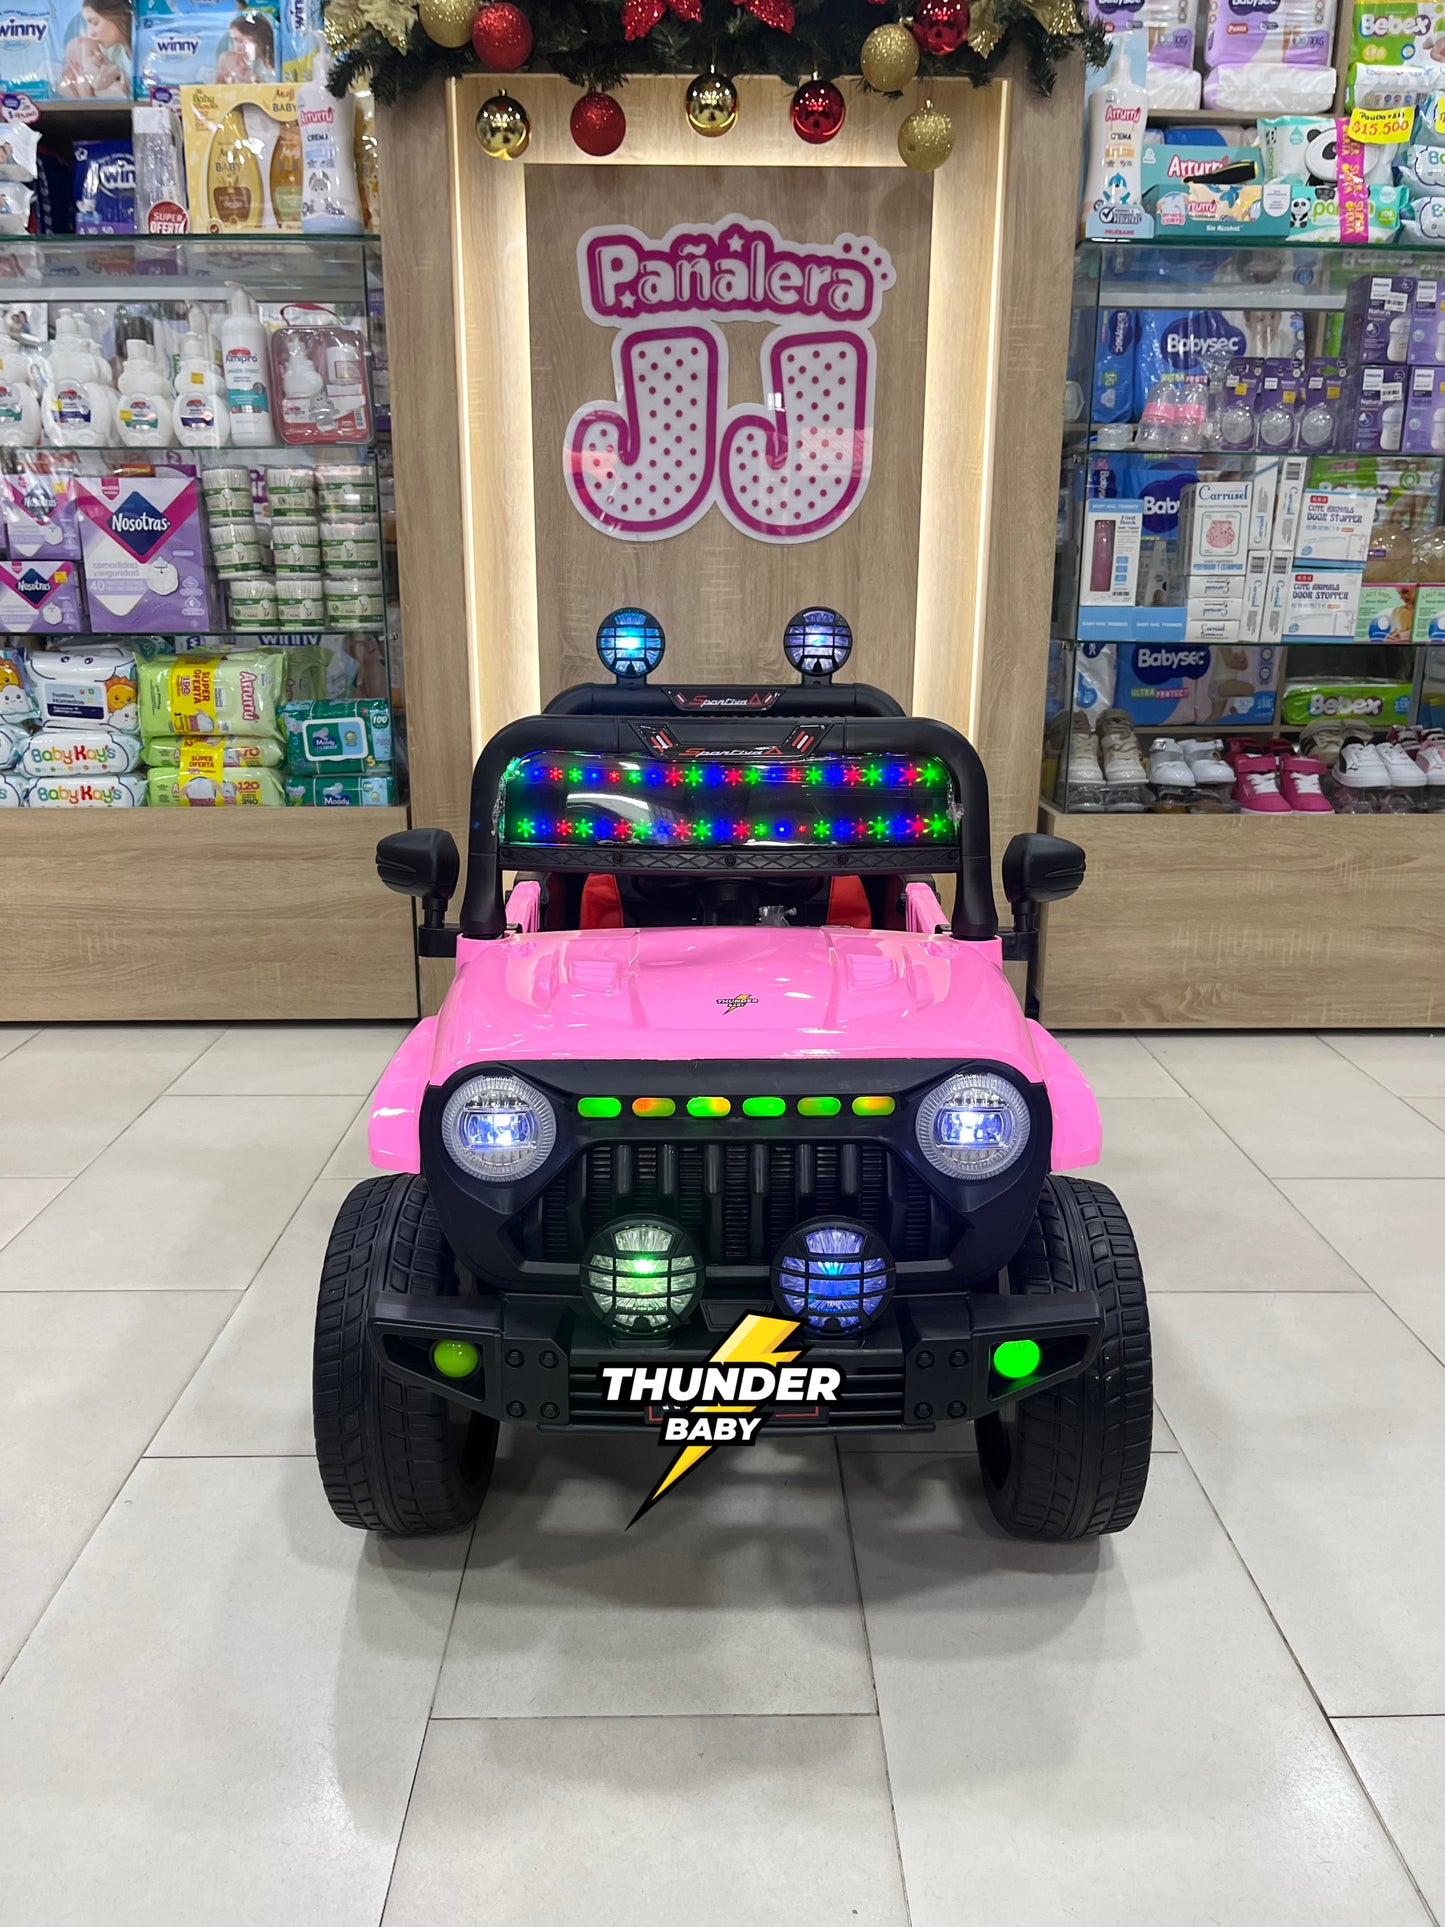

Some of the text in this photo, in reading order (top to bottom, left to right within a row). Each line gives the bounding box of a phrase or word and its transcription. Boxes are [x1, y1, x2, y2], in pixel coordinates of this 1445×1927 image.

[294, 0, 305, 29] win
[1361, 13, 1431, 37] Bebex
[0, 19, 46, 40] winny
[157, 36, 199, 54] winny
[1105, 105, 1142, 122] Arrurrú
[105, 161, 136, 184] win
[592, 238, 868, 314] Pañalera
[1166, 333, 1241, 355] Babysec
[571, 326, 868, 536] JJ
[1199, 484, 1249, 501] Carrusel
[112, 512, 169, 532] Nosotras
[1307, 513, 1363, 523] DOOR STOPPER
[17, 578, 51, 591] Nosotras
[1293, 583, 1311, 591] CUTE
[1292, 591, 1349, 600] DOOR STOPPER
[1137, 648, 1205, 669] Babysec
[193, 669, 202, 705] OFERTA
[239, 671, 261, 722] Arrurrú
[1131, 688, 1189, 699] ULTRA PROTECT
[1309, 693, 1383, 716] Bebex
[238, 781, 260, 790] 120
